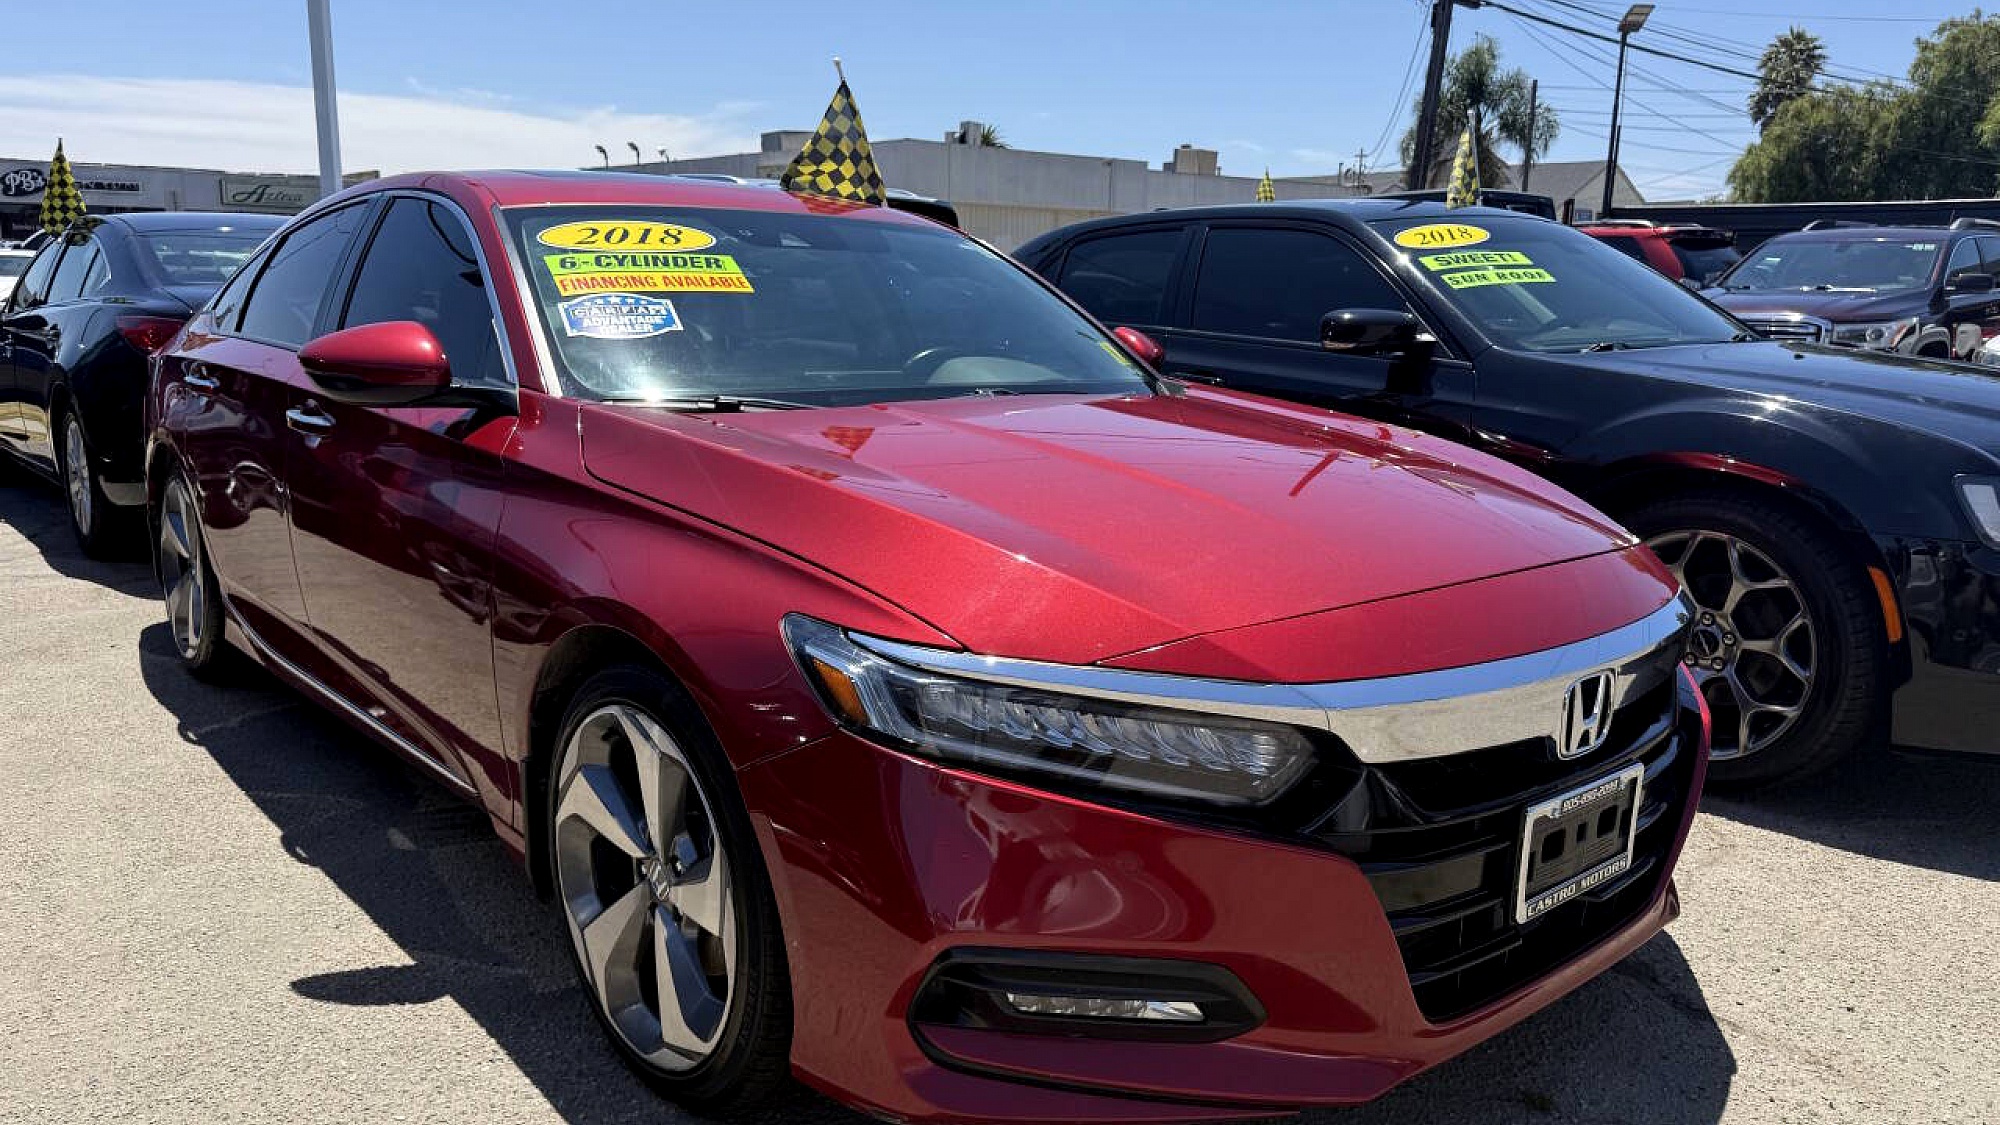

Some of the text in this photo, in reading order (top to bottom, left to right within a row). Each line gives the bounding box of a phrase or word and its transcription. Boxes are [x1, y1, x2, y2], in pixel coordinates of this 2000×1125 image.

[574, 226, 684, 245] 2018
[1413, 226, 1473, 245] 2018
[559, 274, 750, 292] FINANCING AVAILABLE
[1448, 270, 1546, 286] SUN ROOF
[1527, 858, 1628, 917] CASTRO MOTORS
